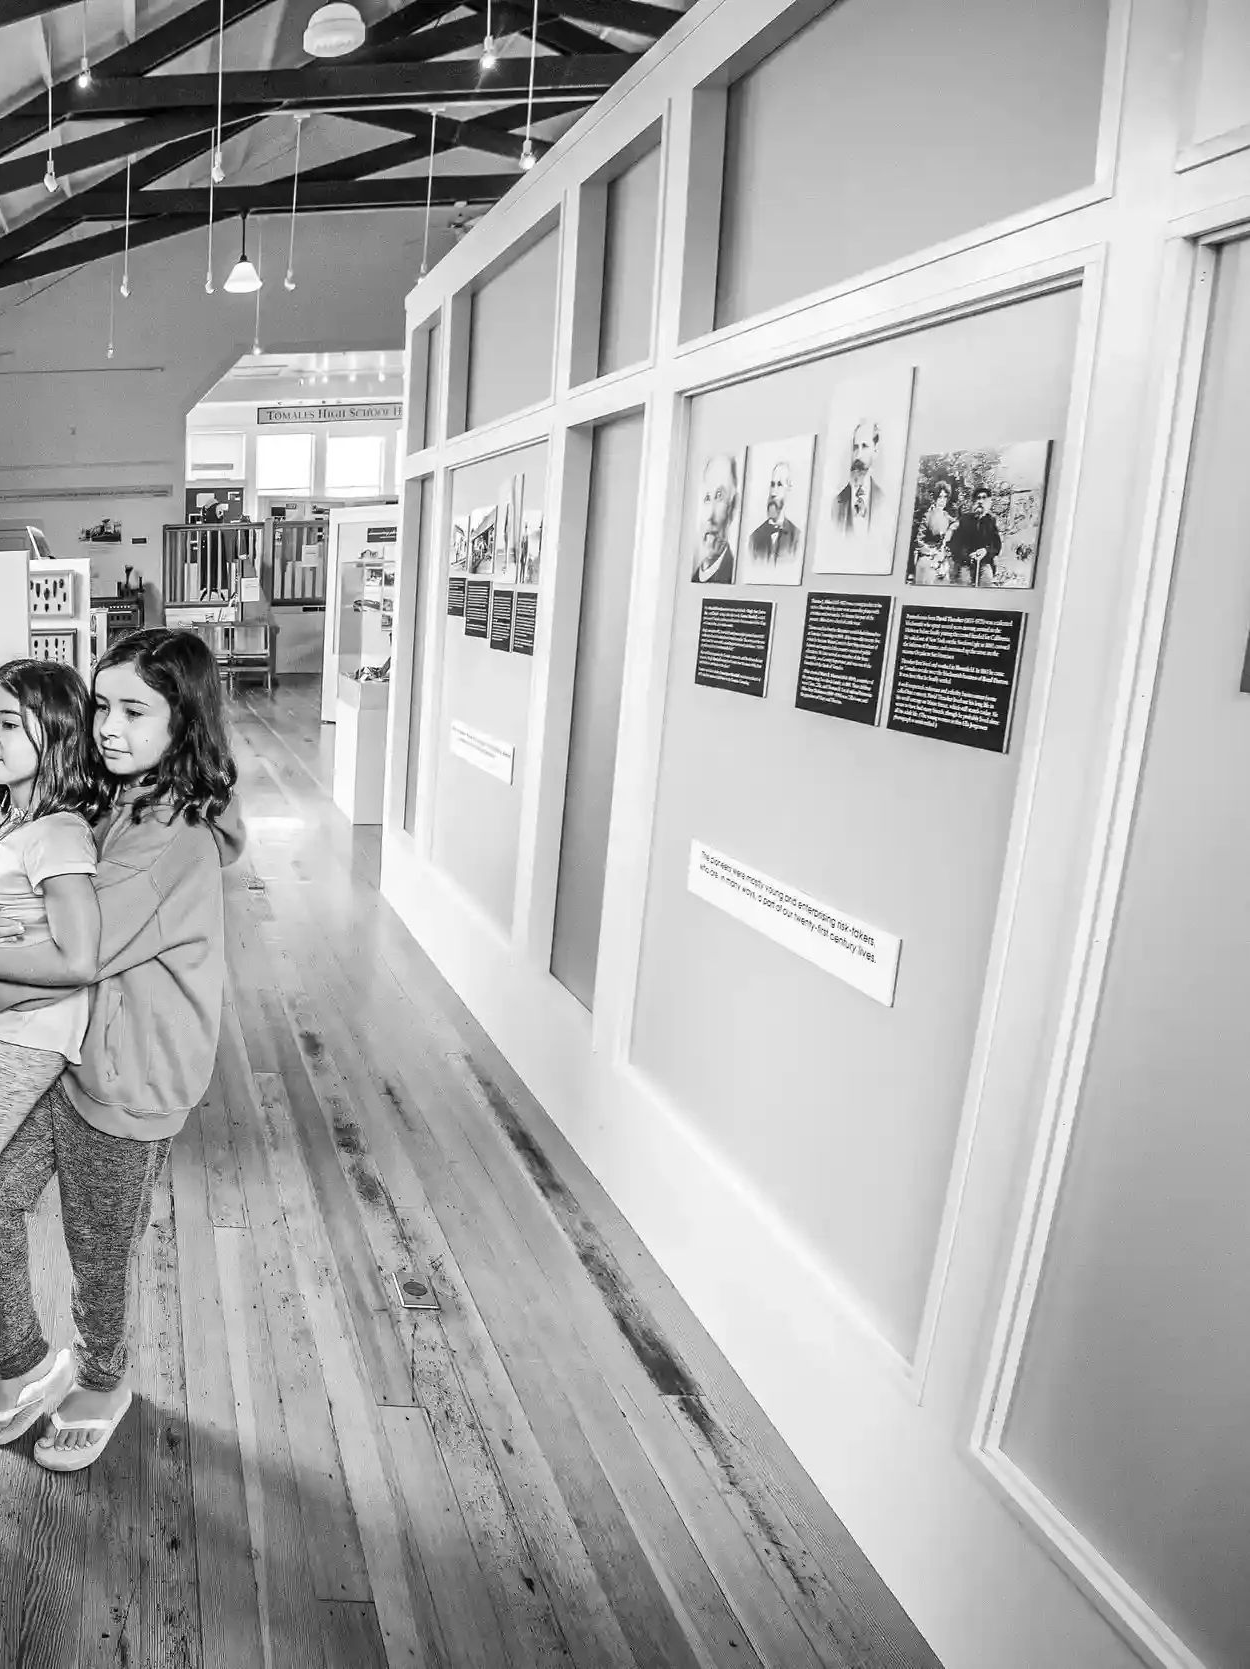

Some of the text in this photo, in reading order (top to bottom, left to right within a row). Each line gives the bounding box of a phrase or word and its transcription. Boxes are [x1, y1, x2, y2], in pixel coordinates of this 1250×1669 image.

[266, 410, 315, 421] TOMALES
[318, 408, 346, 419] HIGH
[349, 406, 390, 418] SCHOOL
[746, 875, 764, 890] mostly
[765, 884, 784, 902] young
[784, 894, 797, 906] and
[798, 901, 836, 928] enterprising
[762, 897, 776, 909] part
[776, 903, 783, 912] of
[783, 908, 794, 918] our
[830, 932, 857, 954] century
[858, 944, 876, 964] lives.
